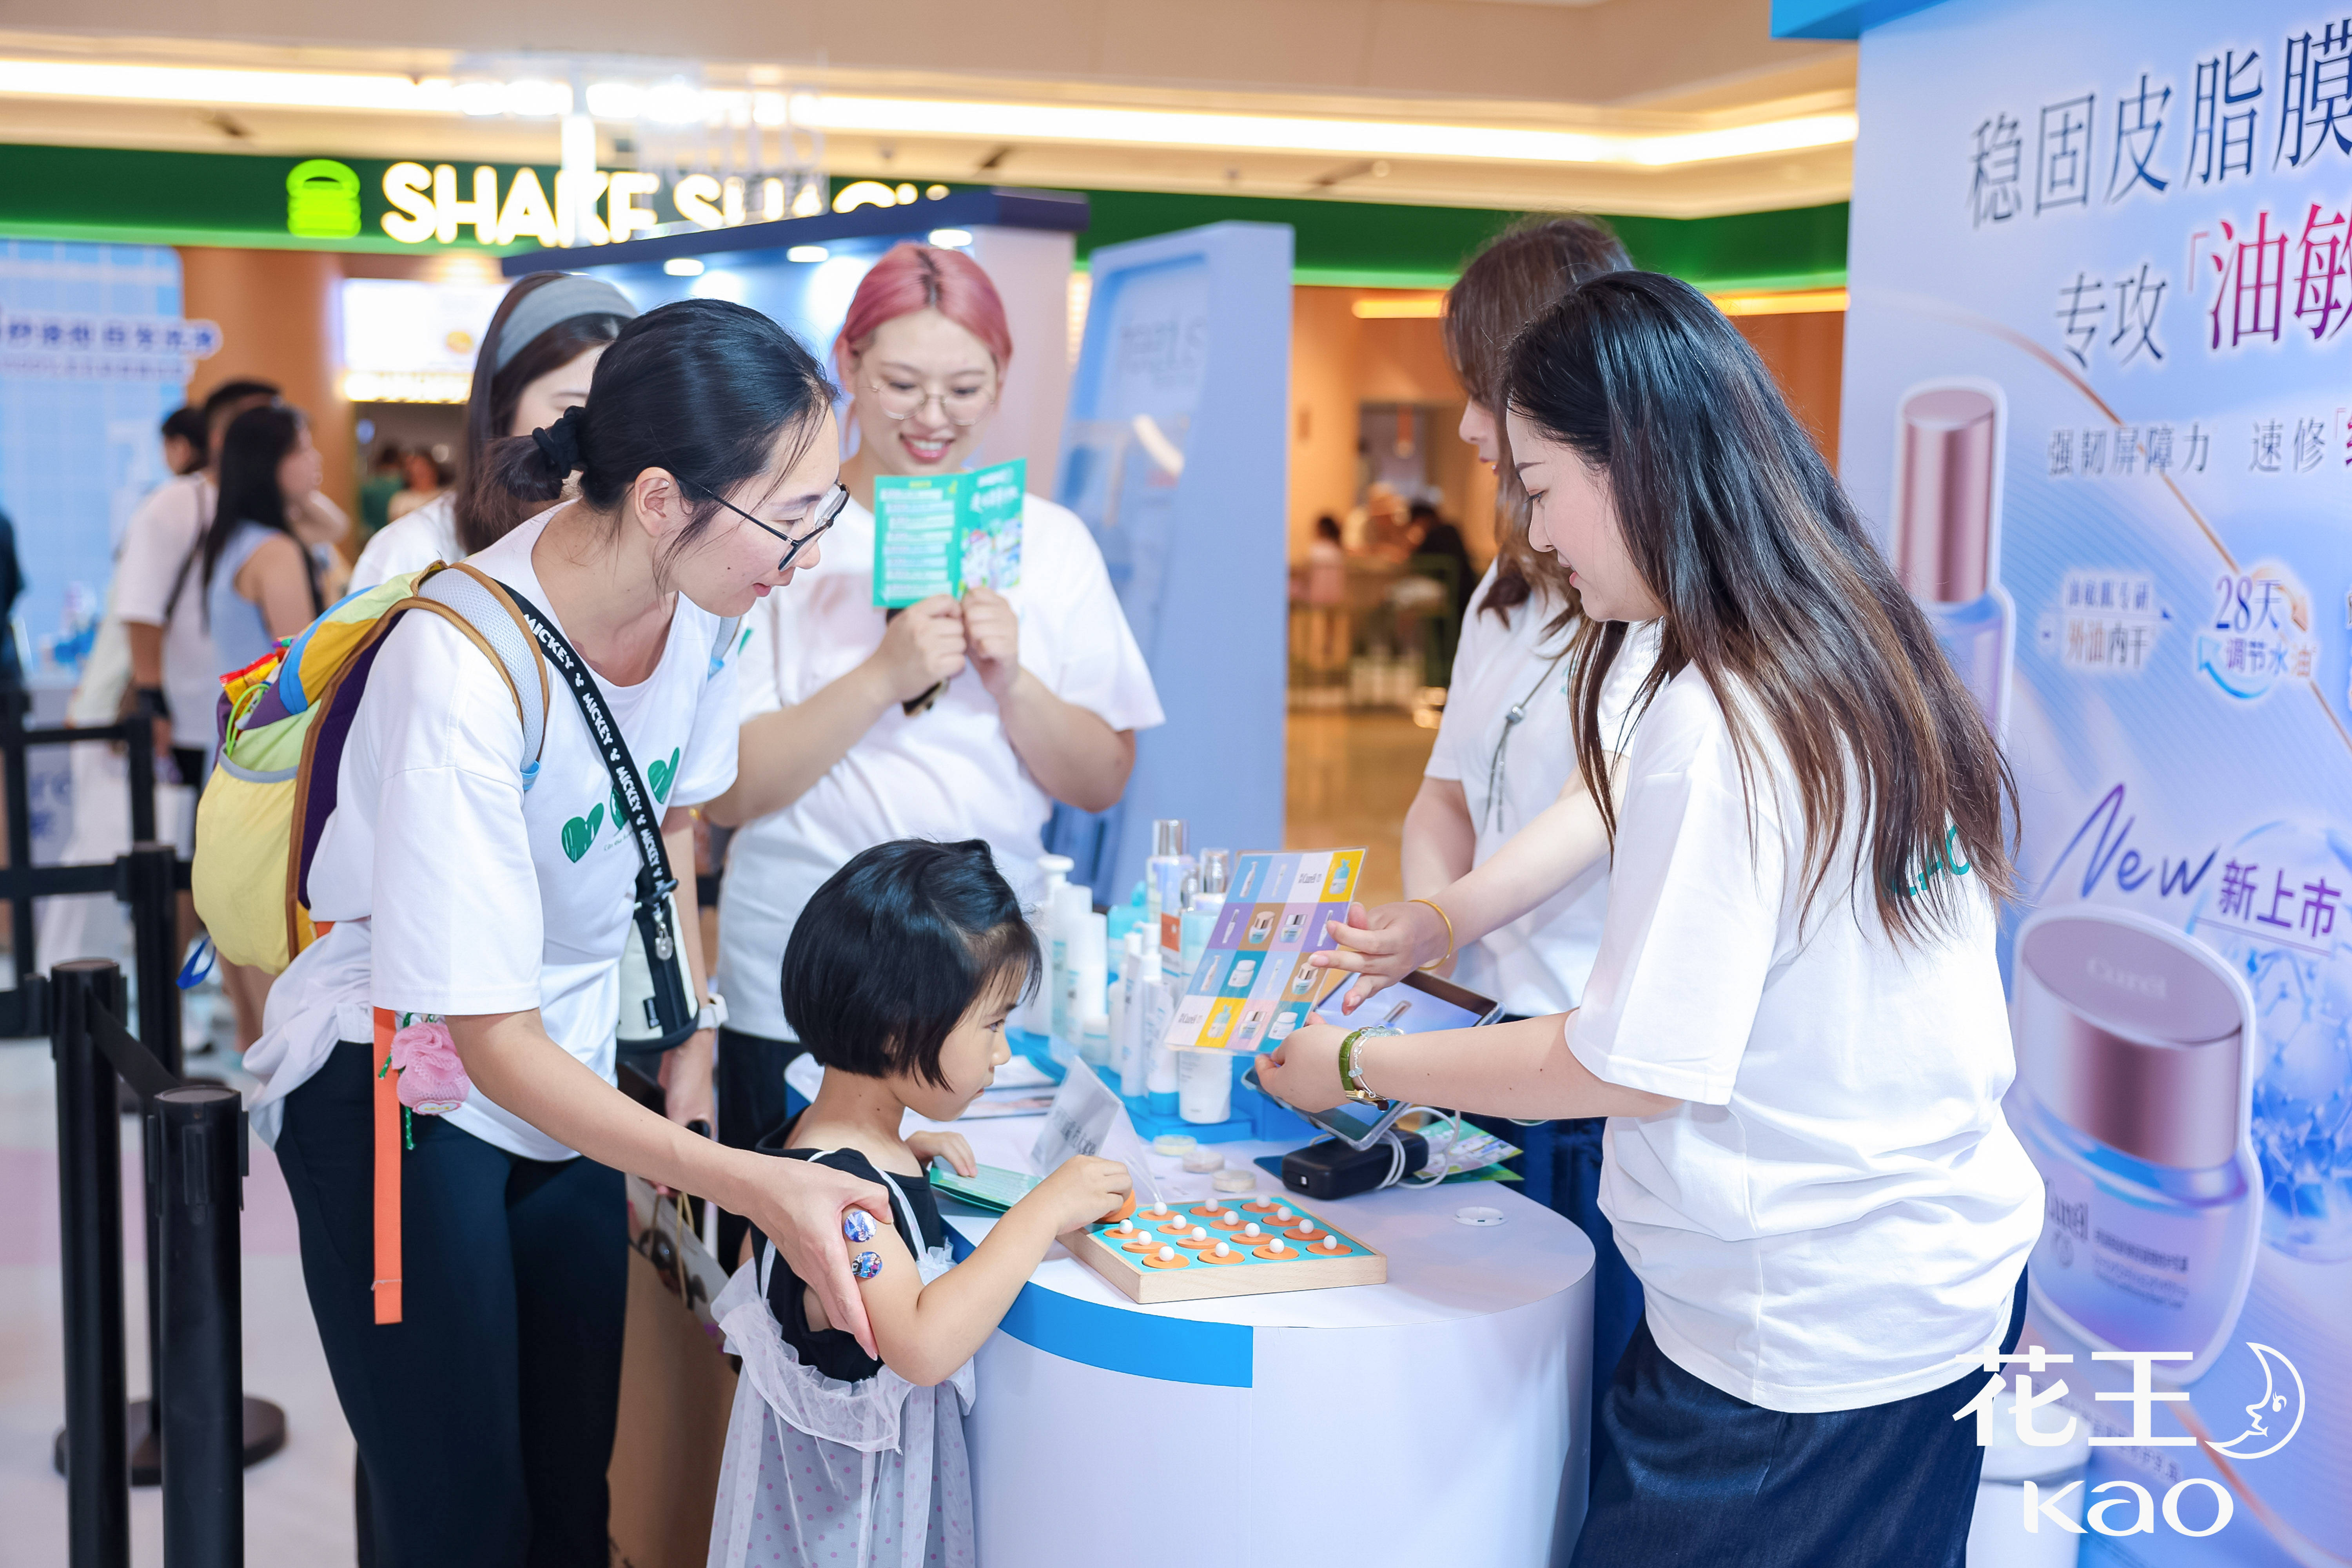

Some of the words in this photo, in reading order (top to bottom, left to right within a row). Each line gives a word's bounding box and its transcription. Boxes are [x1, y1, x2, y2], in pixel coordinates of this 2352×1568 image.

[1966, 18, 2352, 230] 稳固皮脂膜
[2216, 574, 2281, 633] 28天
[523, 614, 574, 669] MICKEY
[583, 692, 613, 745] MICKEY
[616, 766, 642, 812] MICKEY
[2033, 782, 2221, 899] New
[2216, 861, 2341, 938] 新上市
